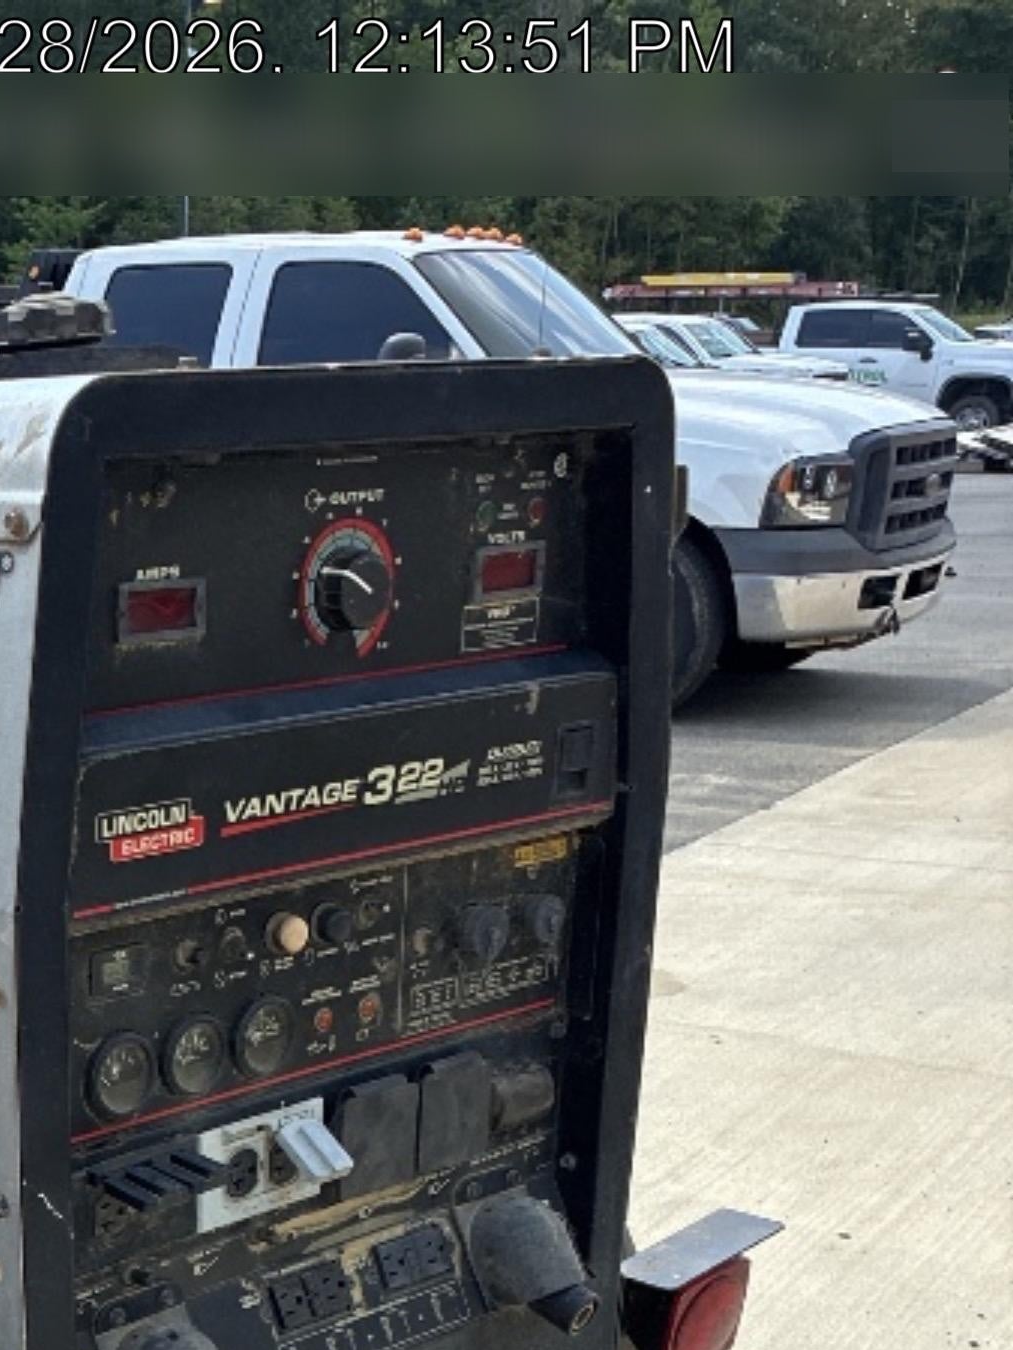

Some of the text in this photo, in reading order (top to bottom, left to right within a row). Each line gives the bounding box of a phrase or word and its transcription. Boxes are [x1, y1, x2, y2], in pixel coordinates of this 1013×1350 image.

[329, 488, 385, 505] OUTPUT
[224, 778, 361, 823] VANTAGE
[363, 757, 445, 805] 322
[101, 803, 187, 838] LINCOLN
[120, 826, 196, 856] ELECTRIC
